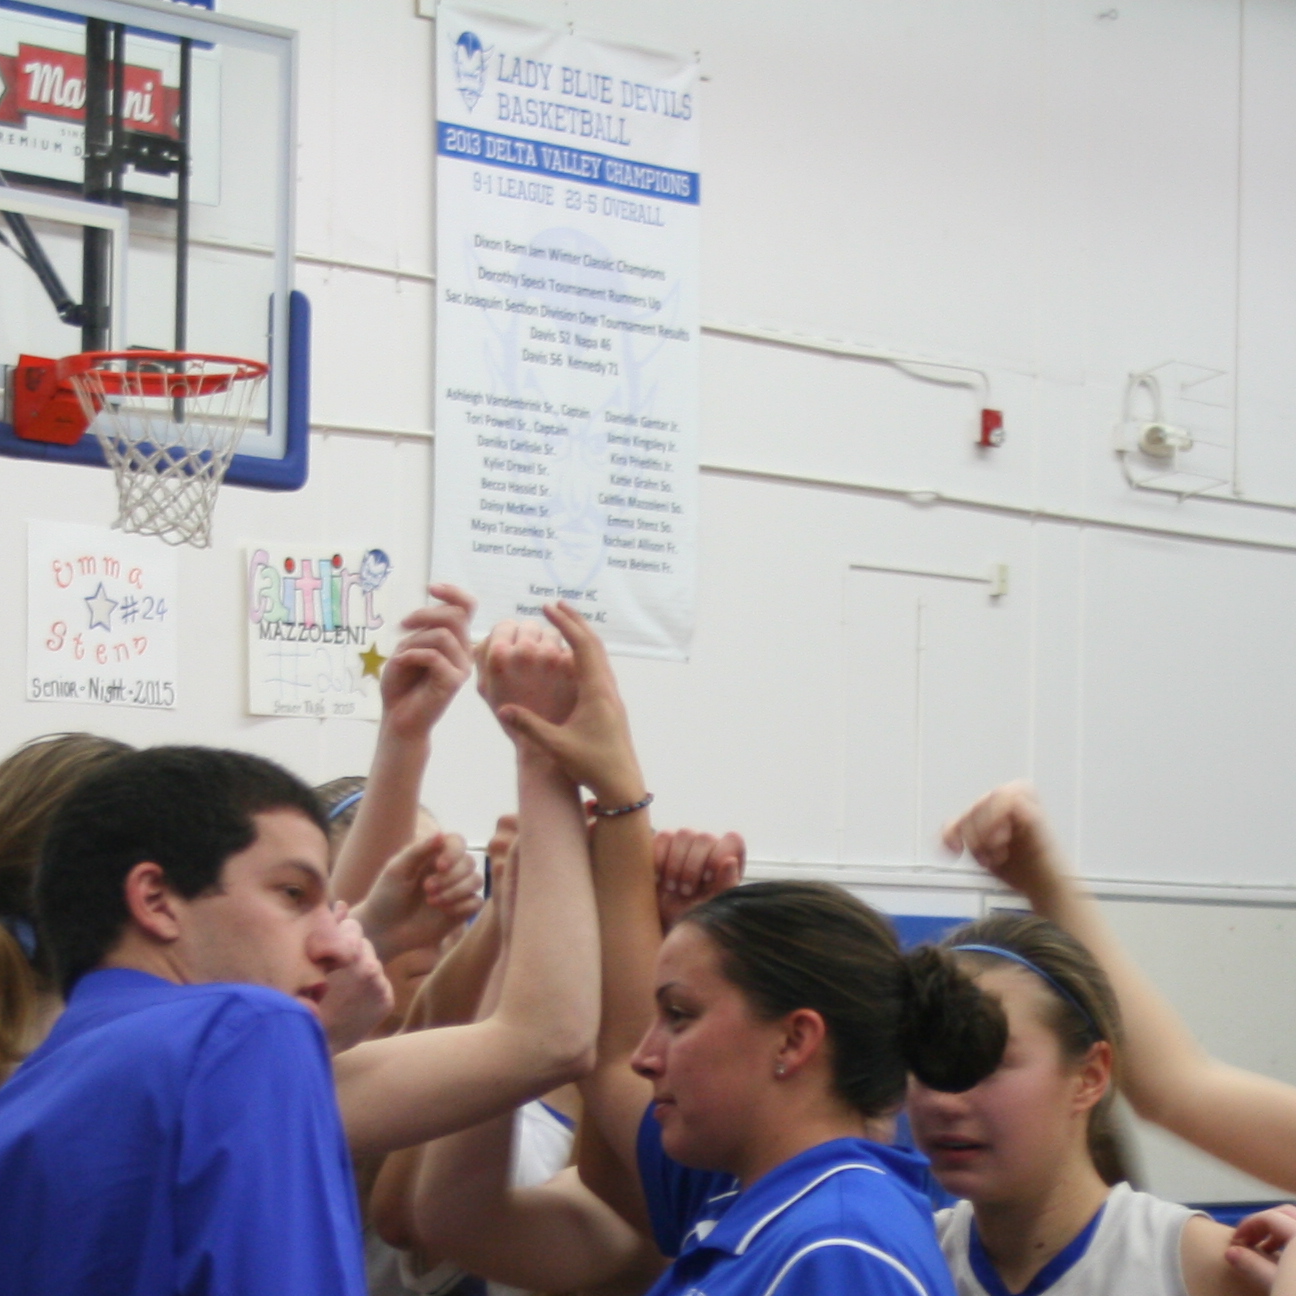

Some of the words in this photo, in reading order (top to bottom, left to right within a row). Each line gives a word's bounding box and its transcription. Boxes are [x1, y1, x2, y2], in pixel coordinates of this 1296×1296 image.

[497, 54, 552, 91] LADY
[562, 67, 613, 104] BLUE
[622, 81, 692, 120] DEVILS
[497, 93, 630, 145] BASKETBALL
[446, 128, 481, 155] 2013
[485, 136, 538, 167] DELTA
[542, 147, 602, 179] VALLEY
[606, 159, 690, 197] CHAMPIONS
[473, 172, 492, 193] 9-1
[498, 176, 554, 206] LEAGUE
[565, 189, 597, 214] 23-5
[604, 197, 664, 227] OVERALL
[617, 260, 666, 281] Champions
[548, 278, 607, 300] Tournament
[648, 296, 661, 311] Up
[505, 298, 539, 315] Section
[599, 314, 656, 335] Tournament
[530, 326, 556, 343] Davis
[522, 348, 548, 364] Davis
[608, 361, 619, 376] 71
[53, 555, 144, 589] Emma
[119, 596, 168, 623] #24
[259, 622, 366, 645] MAZZOLENI
